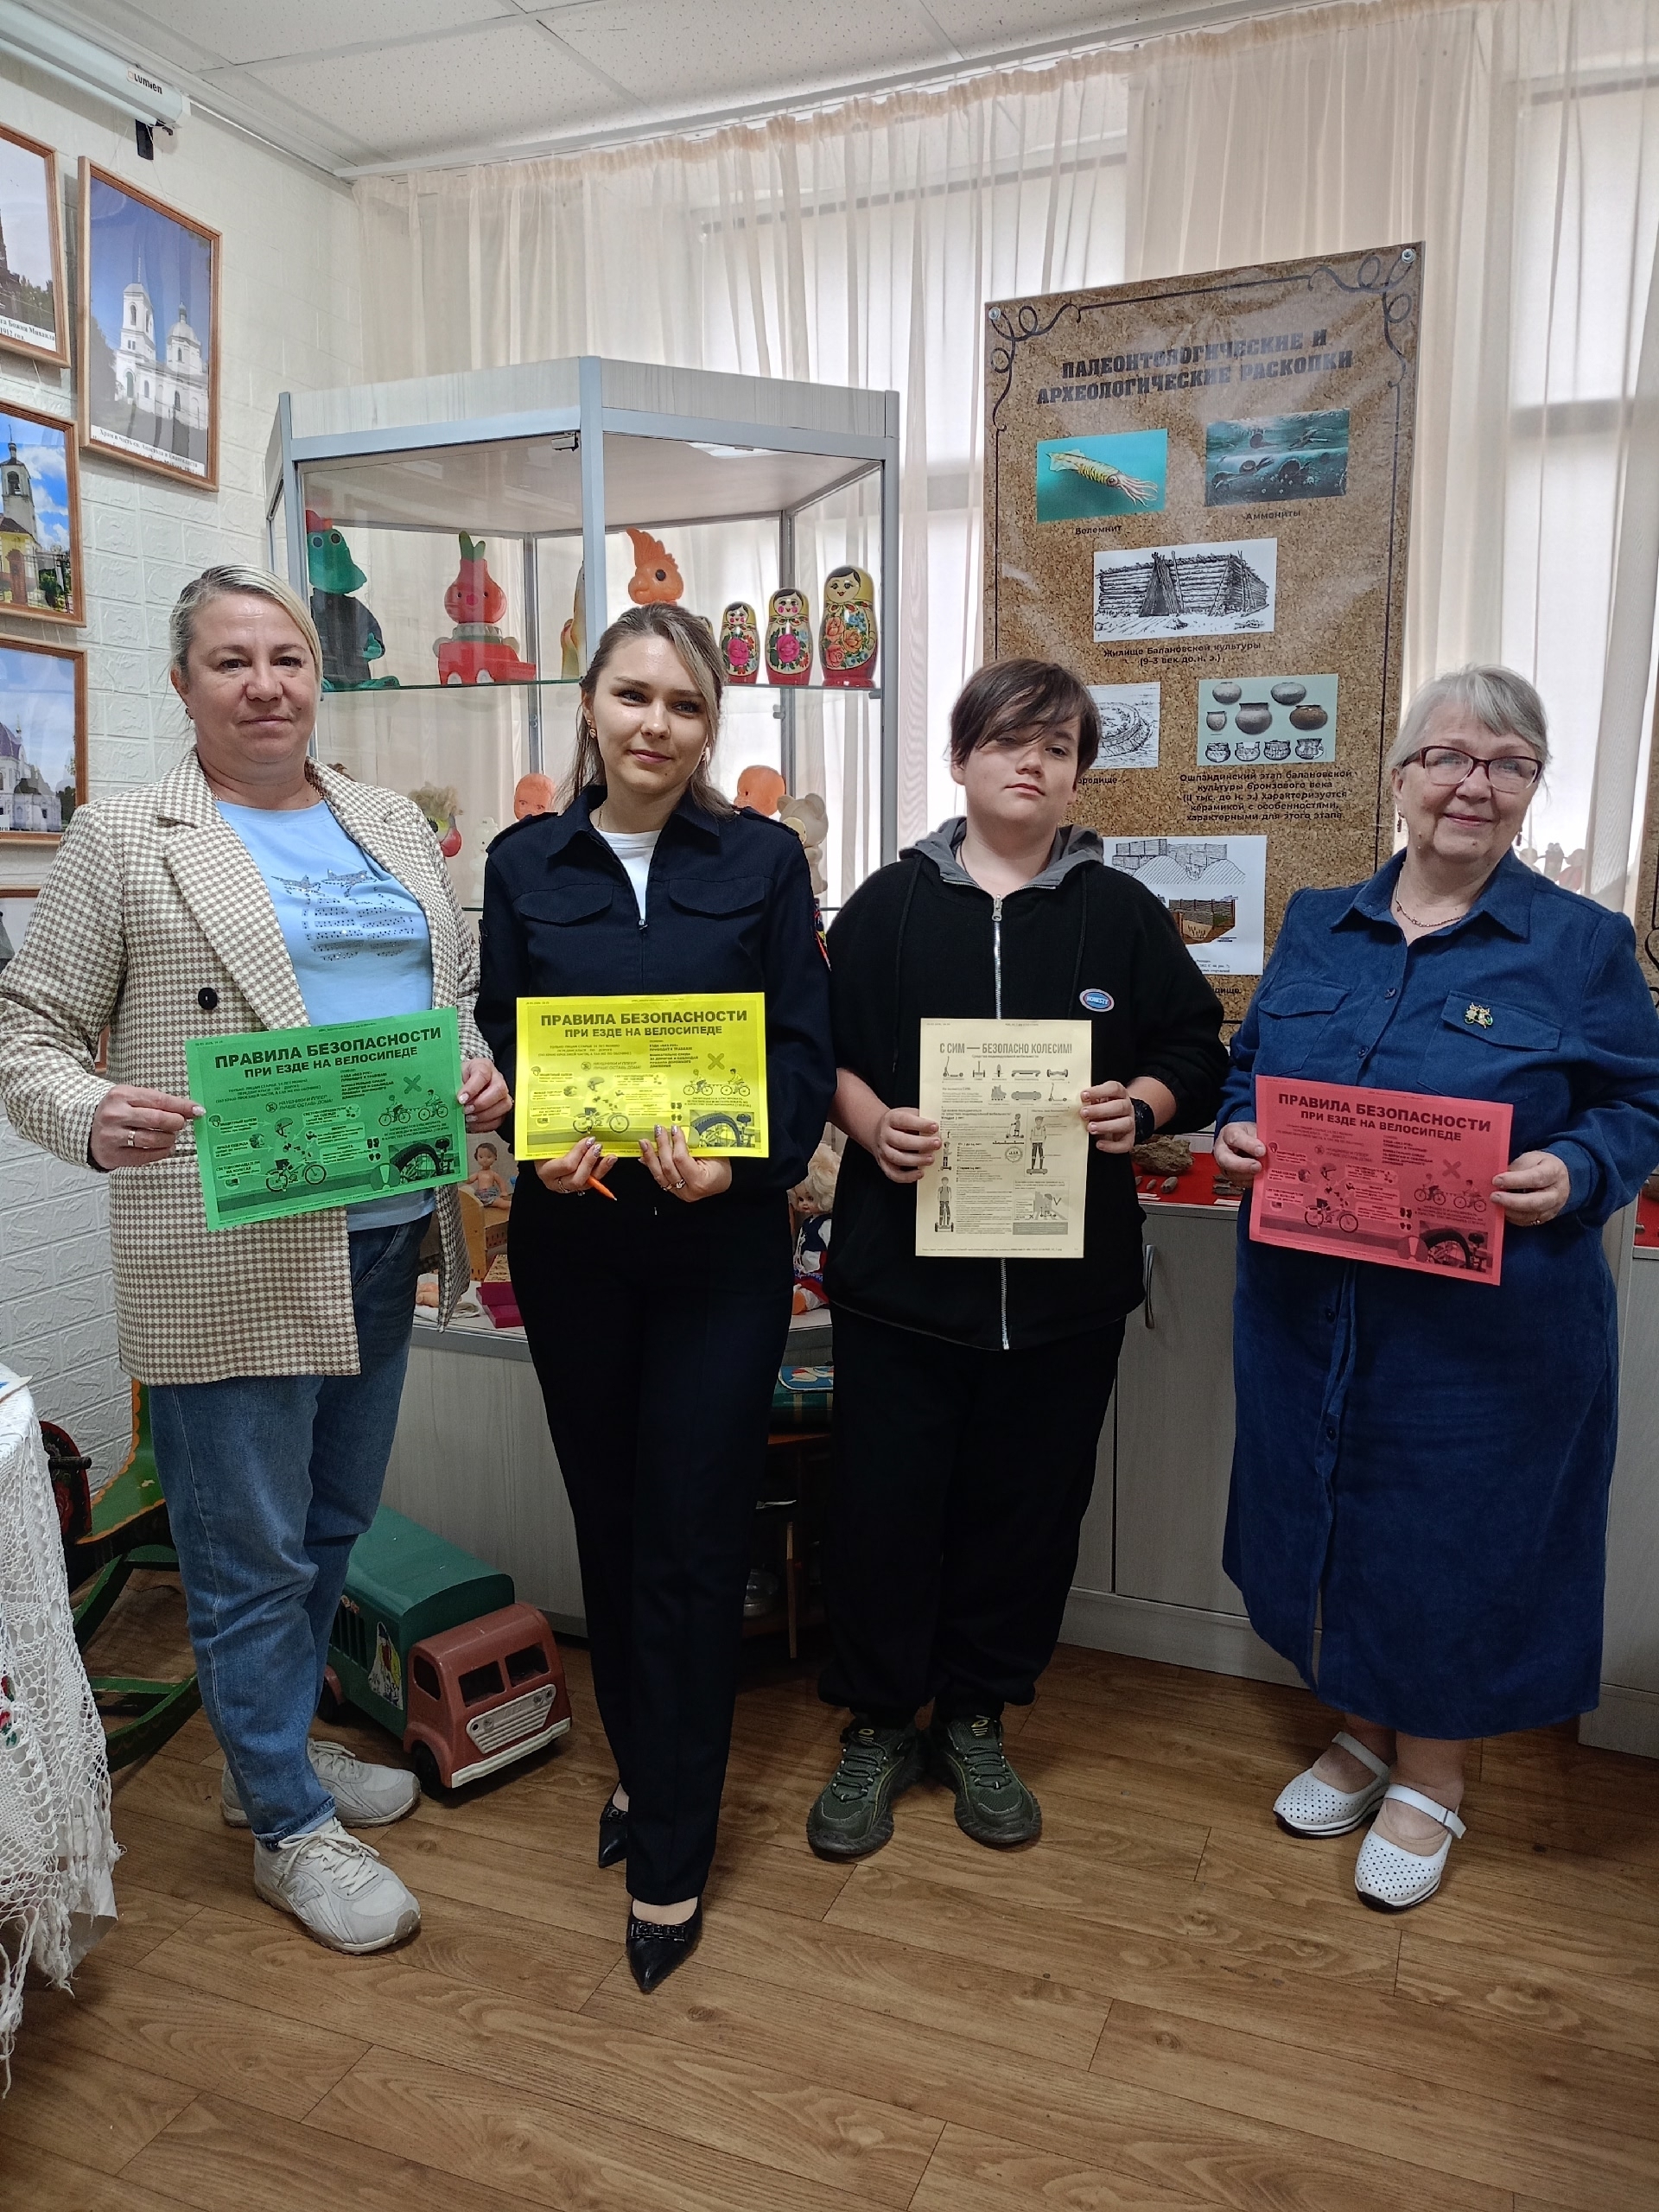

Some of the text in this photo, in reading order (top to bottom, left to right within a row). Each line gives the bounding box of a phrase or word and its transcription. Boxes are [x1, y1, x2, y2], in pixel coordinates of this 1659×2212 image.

[1062, 328, 1327, 379] ПАЛЕОНТОЛОГИЧЕСКИЕ И
[1037, 350, 1353, 404] АРХЕОЛОГИЧЕСКИЕ РАСКОПКИ
[1246, 509, 1301, 520] Аммониты
[1103, 642, 1261, 658] Жилище Балановской культуры
[1179, 772, 1256, 782] Ошпандинский
[1286, 770, 1352, 779] балановской
[1198, 784, 1243, 792] культуры
[1247, 782, 1306, 791] бронзового
[1262, 791, 1347, 800] характеризуется
[1191, 804, 1244, 812] керамикой
[541, 1010, 747, 1026] ПРАВИЛА БЕЗОПАСНОСТИ
[565, 1026, 722, 1038] ПРИ ЕЗДЕ НА ВЕЛОСИПЕДЕ
[215, 1047, 302, 1068] ПРАВИЛА
[307, 1027, 442, 1057] БЕЗОПАСНОСТИ
[946, 1043, 965, 1053] СИМ
[982, 1043, 1029, 1053] БЕЗОПАСНО
[1031, 1043, 1072, 1054] КОЛЕСИМ!
[245, 1046, 418, 1077] ПРИ ЕЗДЕ НА ВЕЛОСИПЕДЕ
[1279, 1093, 1491, 1132] ПРАВИЛА БЕЗОПАСНОСТИ
[1301, 1110, 1461, 1141] ПРИ ЕЗДЕ НА ВЕЛОСИПЕДЕ
